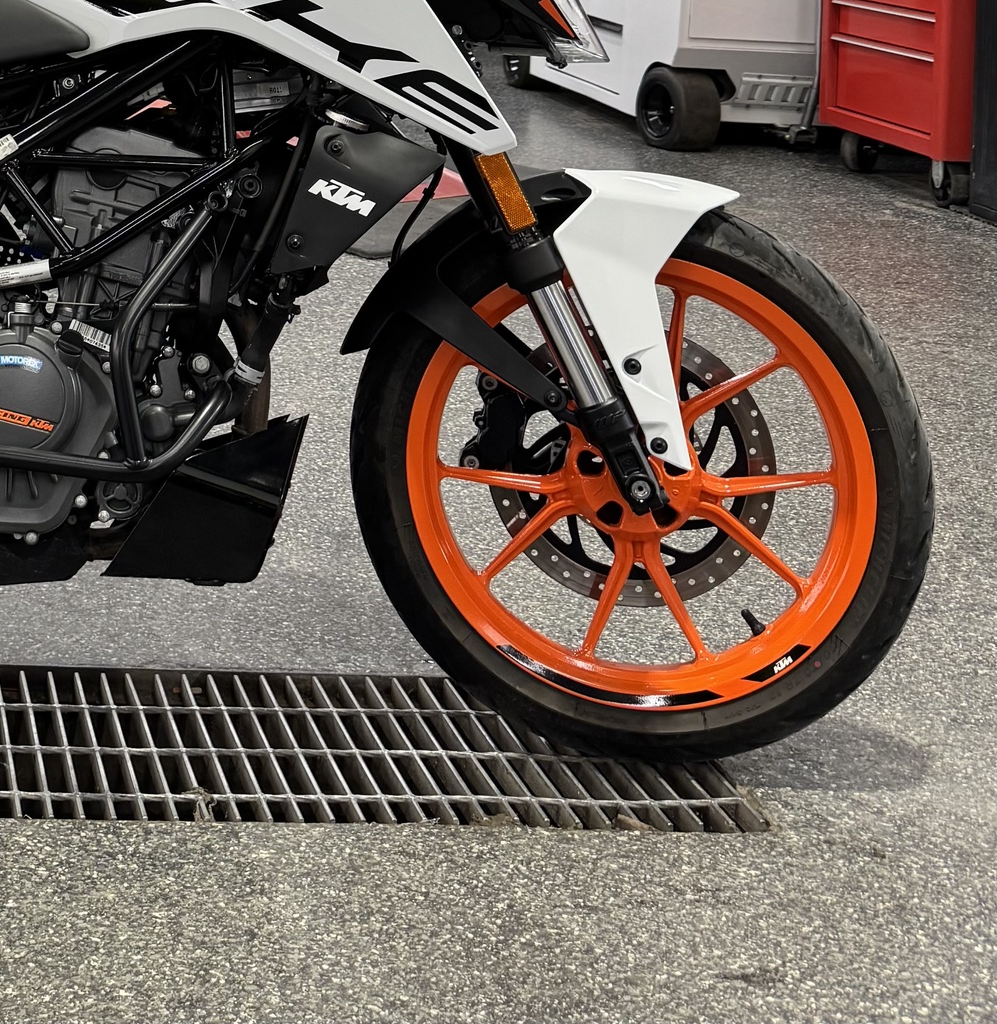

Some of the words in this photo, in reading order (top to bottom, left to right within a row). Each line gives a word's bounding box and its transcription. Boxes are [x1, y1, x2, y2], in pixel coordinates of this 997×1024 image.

[308, 179, 376, 217] KTM
[0, 354, 40, 369] MOTOREX
[30, 417, 55, 432] KTM
[773, 655, 793, 674] KTM
